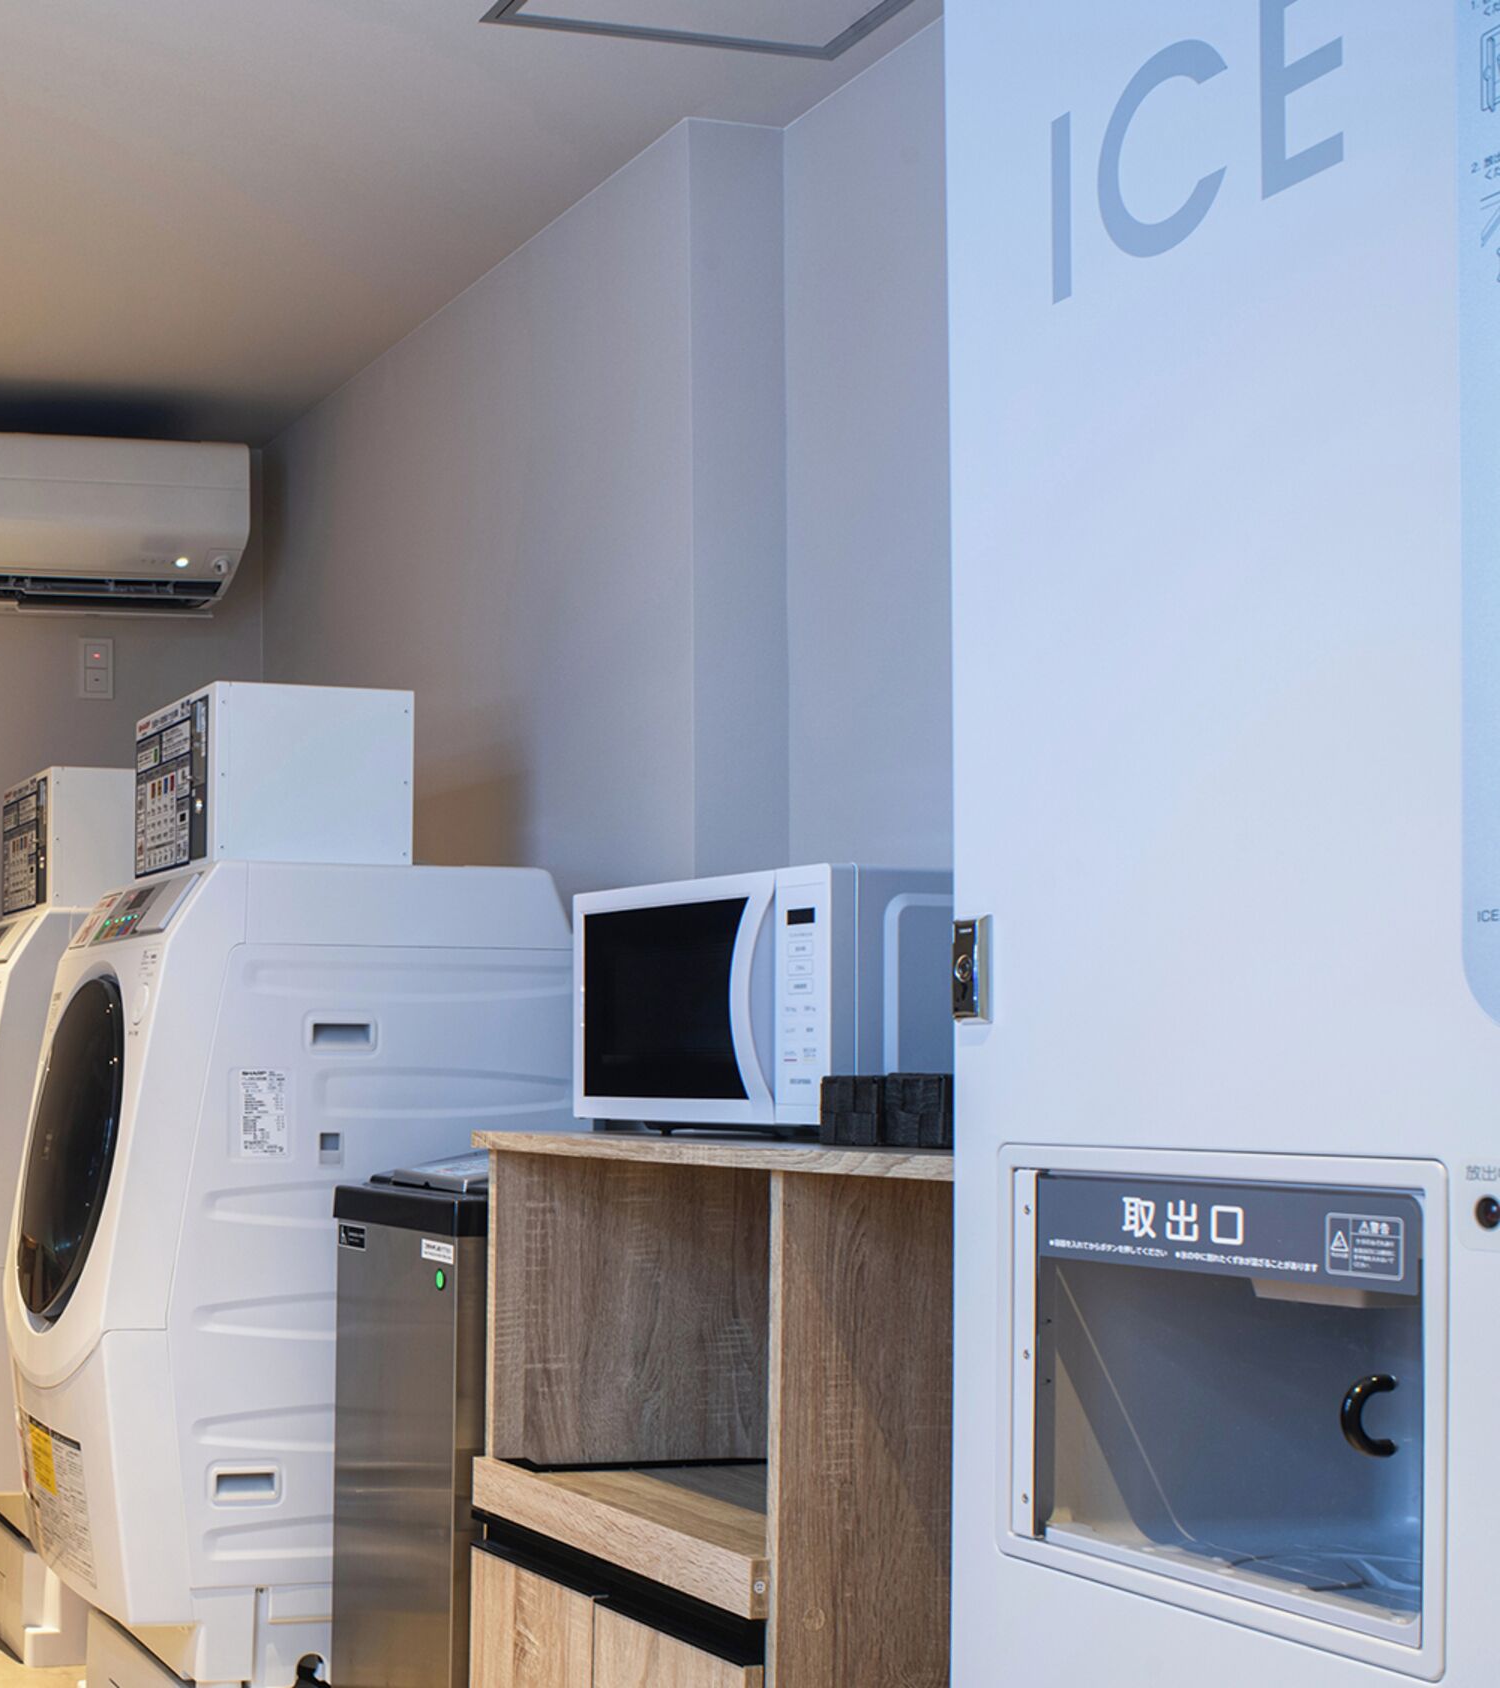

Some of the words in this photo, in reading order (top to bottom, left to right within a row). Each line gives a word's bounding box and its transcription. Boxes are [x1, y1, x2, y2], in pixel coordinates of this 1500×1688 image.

[1051, 0, 1345, 305] ICE
[1465, 1165, 1500, 1181] 放出
[1121, 1196, 1245, 1246] 取出口
